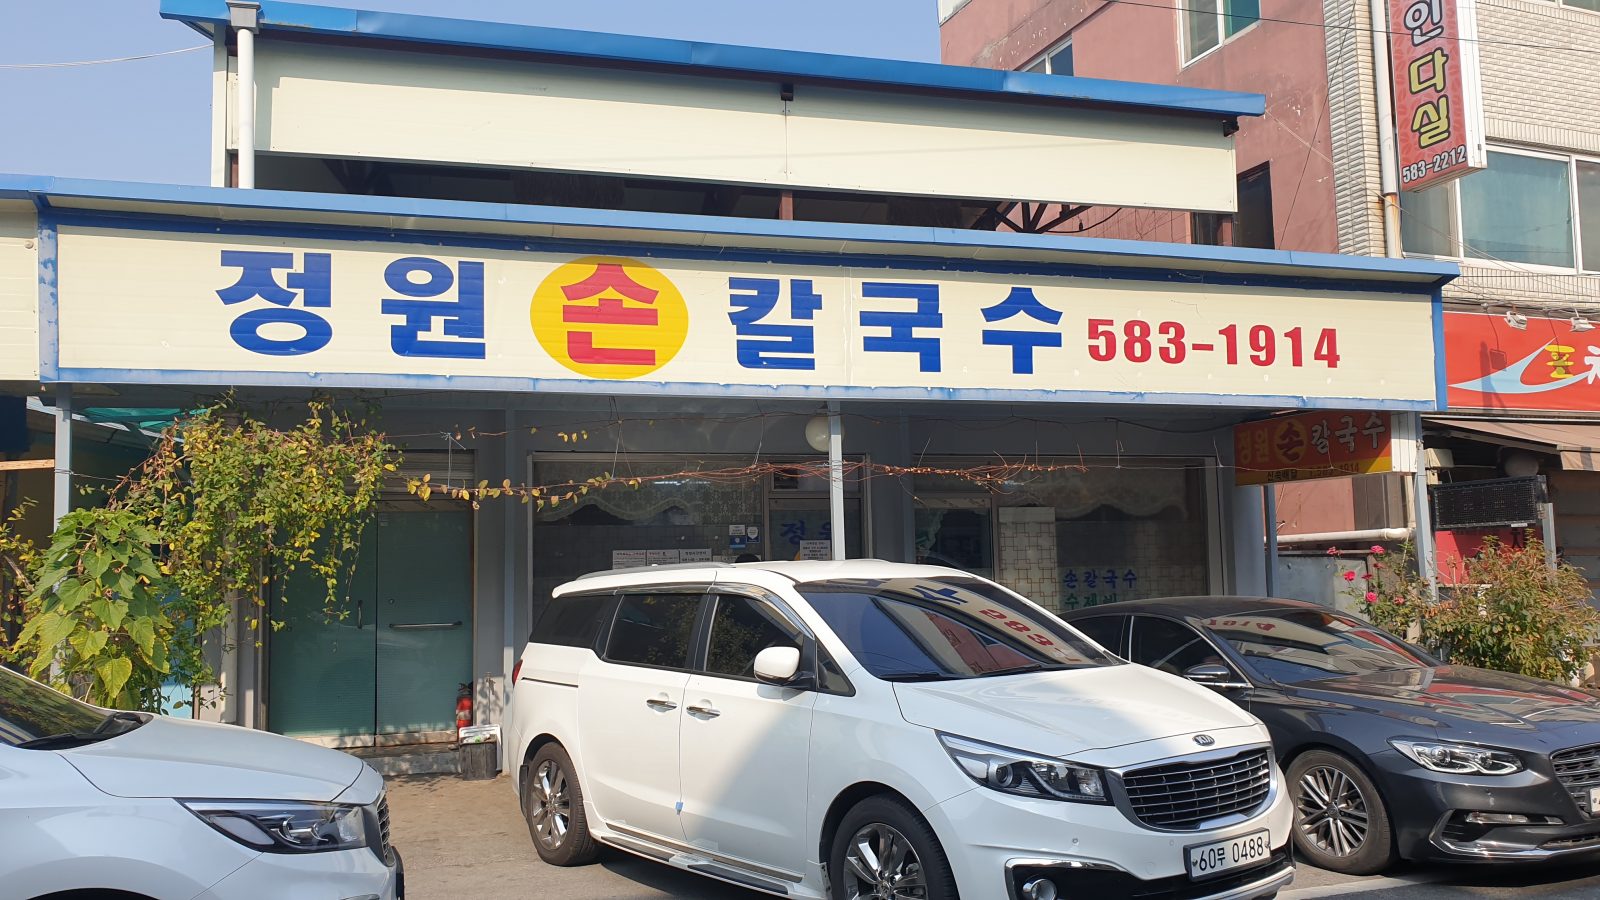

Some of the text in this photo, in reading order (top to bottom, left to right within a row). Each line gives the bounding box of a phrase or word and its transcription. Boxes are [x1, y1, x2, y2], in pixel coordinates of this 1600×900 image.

[1402, 145, 1467, 184] 583-2212
[1087, 318, 1341, 369] 583-1914
[1199, 836, 1264, 872] 60무 0488
